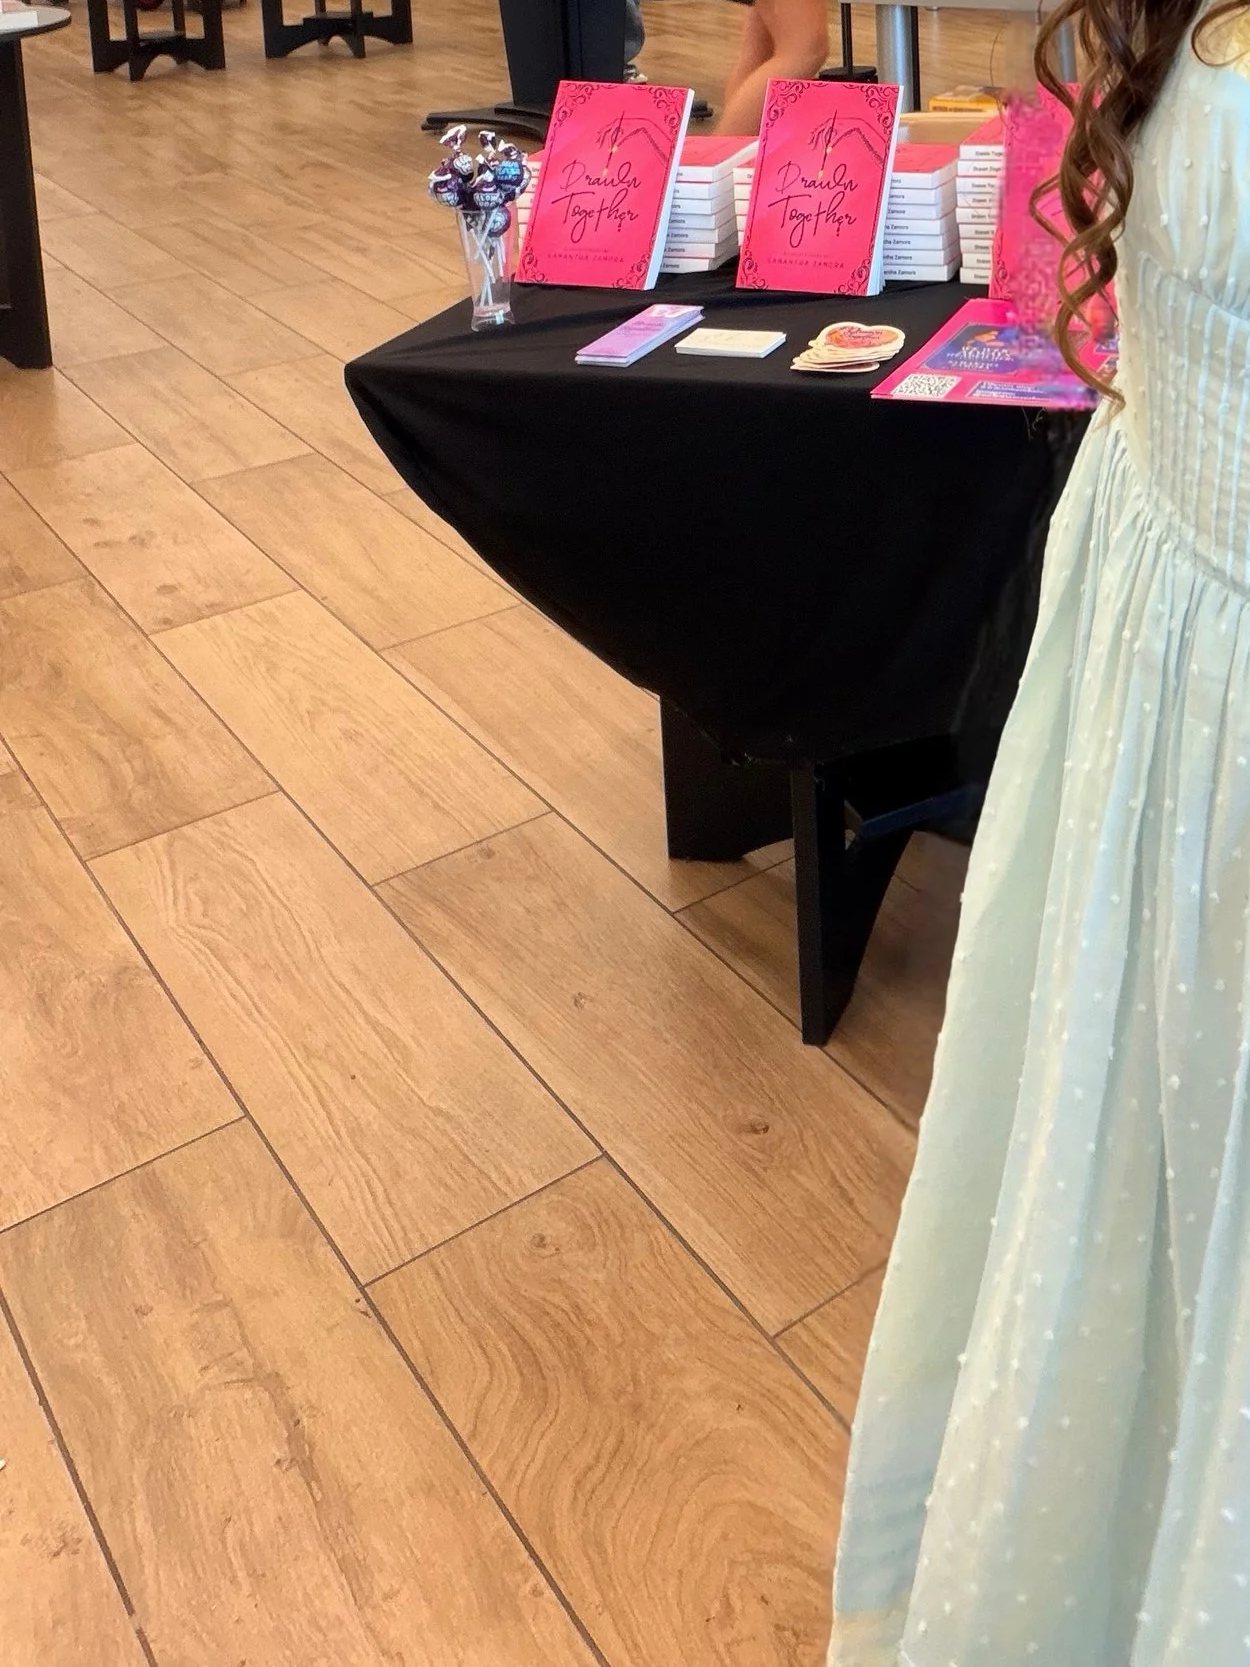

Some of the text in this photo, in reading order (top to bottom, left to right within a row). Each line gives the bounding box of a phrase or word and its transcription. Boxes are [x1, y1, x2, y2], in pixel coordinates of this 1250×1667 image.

[560, 160, 641, 192] Drawn
[775, 161, 858, 194] Drawn
[551, 188, 639, 244] Together
[768, 191, 857, 248] Together
